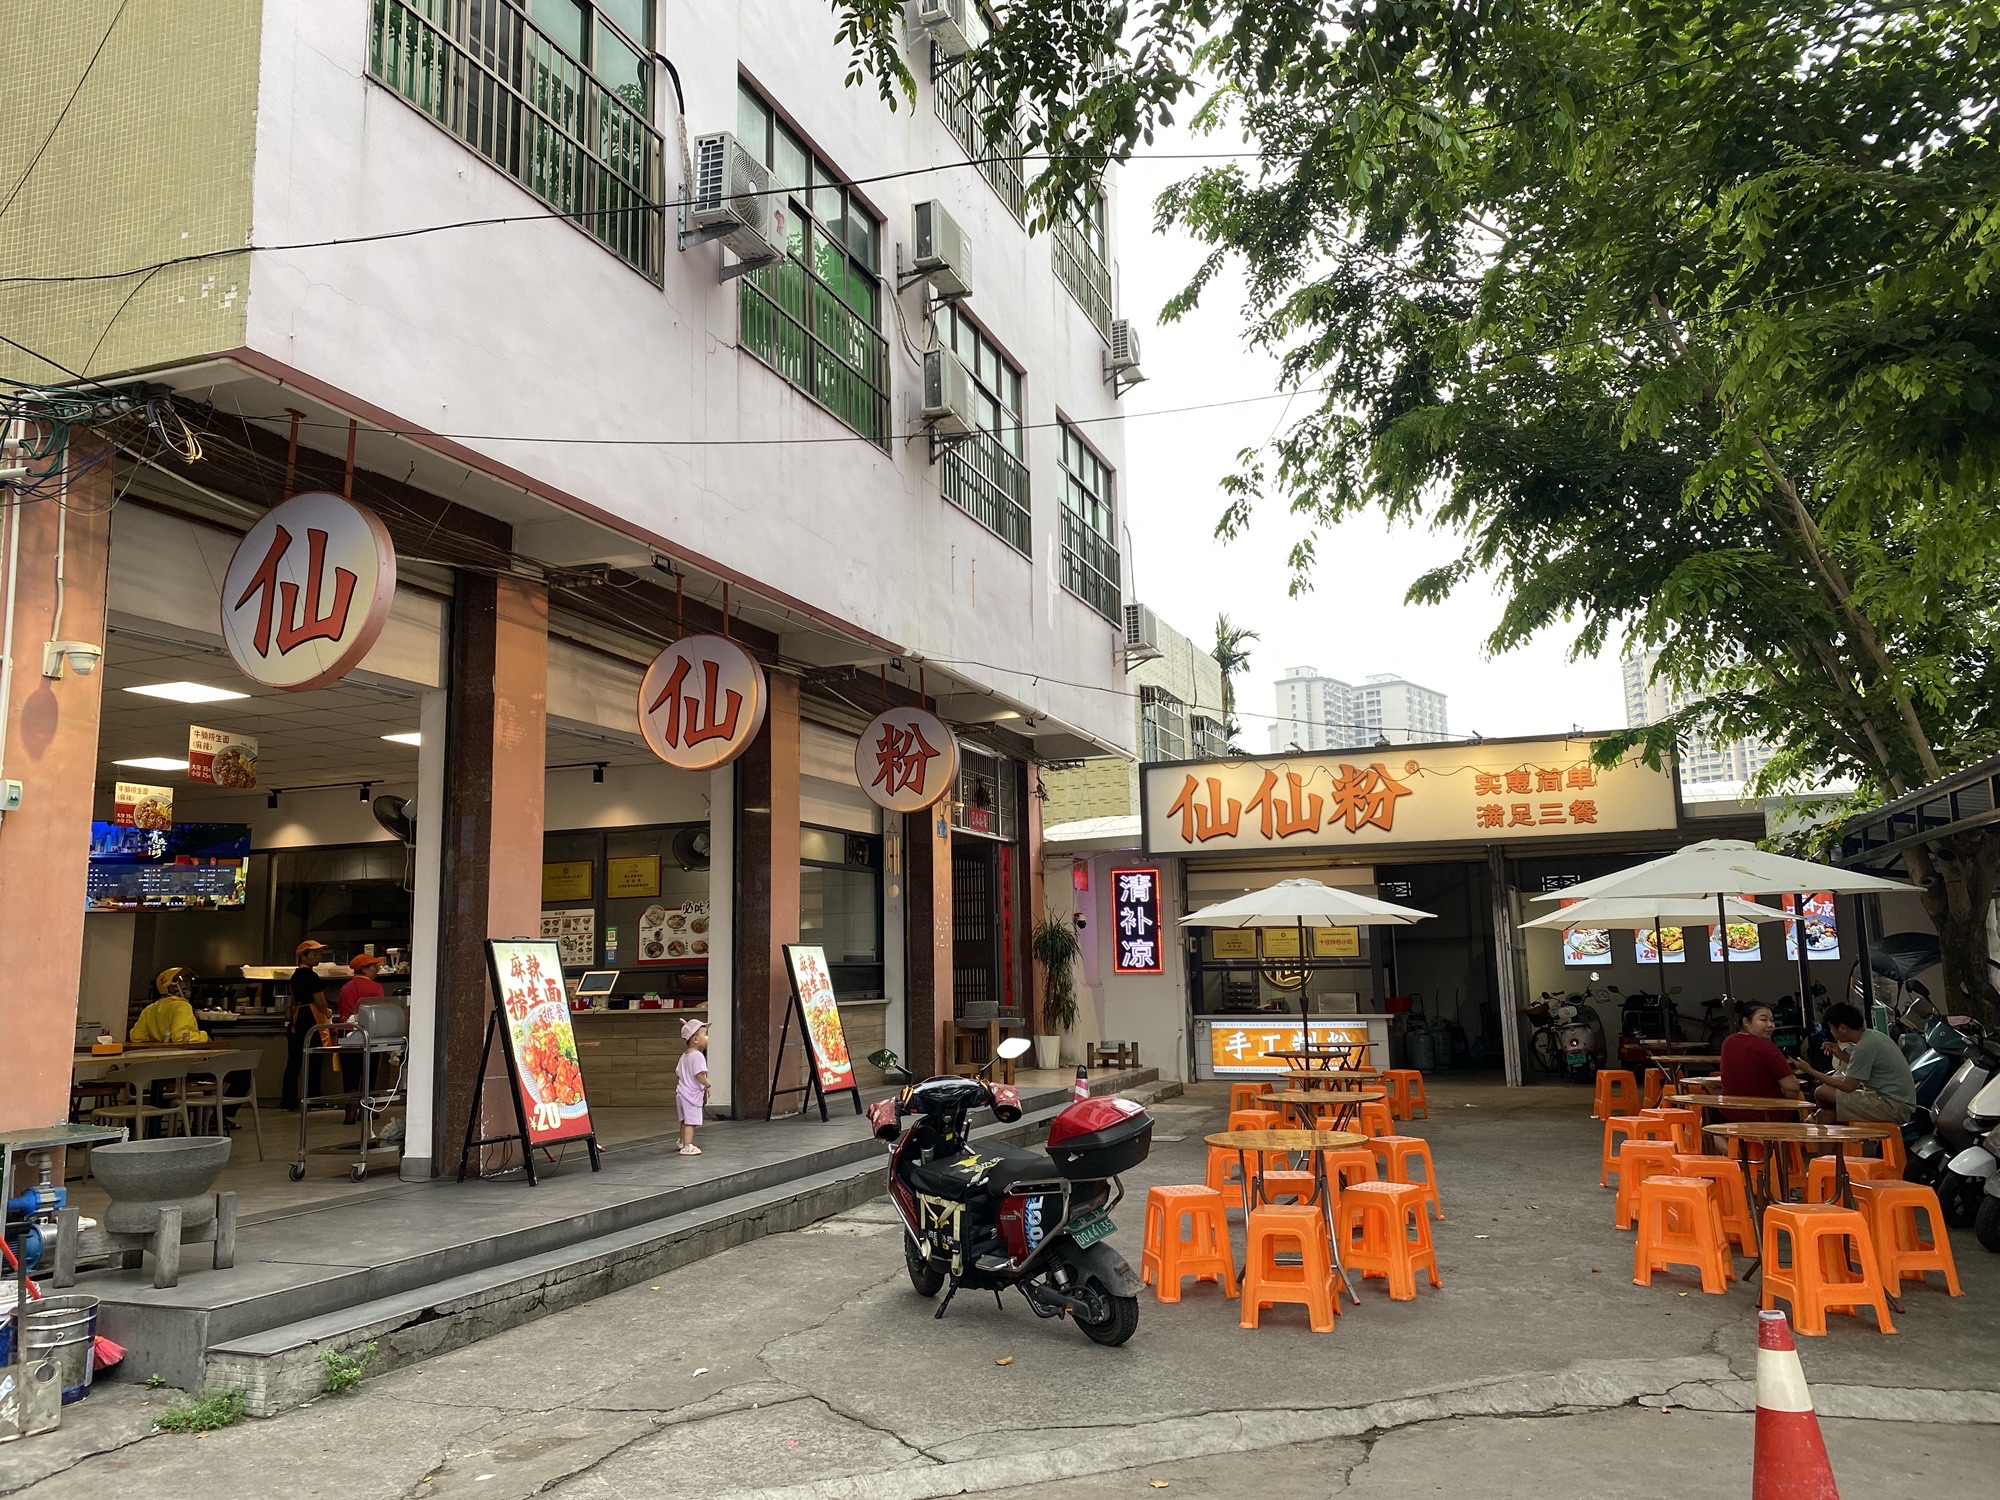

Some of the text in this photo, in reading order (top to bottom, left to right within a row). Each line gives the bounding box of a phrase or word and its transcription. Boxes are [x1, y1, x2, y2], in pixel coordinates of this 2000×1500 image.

[235, 524, 358, 658] 仙
[648, 655, 743, 749] 仙
[872, 723, 941, 797] 粉
[1475, 766, 1596, 796] 实惠简单
[1167, 762, 1412, 844] 仙仙粉
[1476, 799, 1598, 828] 满足三餐
[1119, 874, 1155, 968] 清补凉
[510, 953, 544, 983] 麻辣
[506, 978, 562, 1021] 捞生面
[529, 1102, 561, 1131] ¥20
[1076, 1219, 1115, 1246] 0044135
